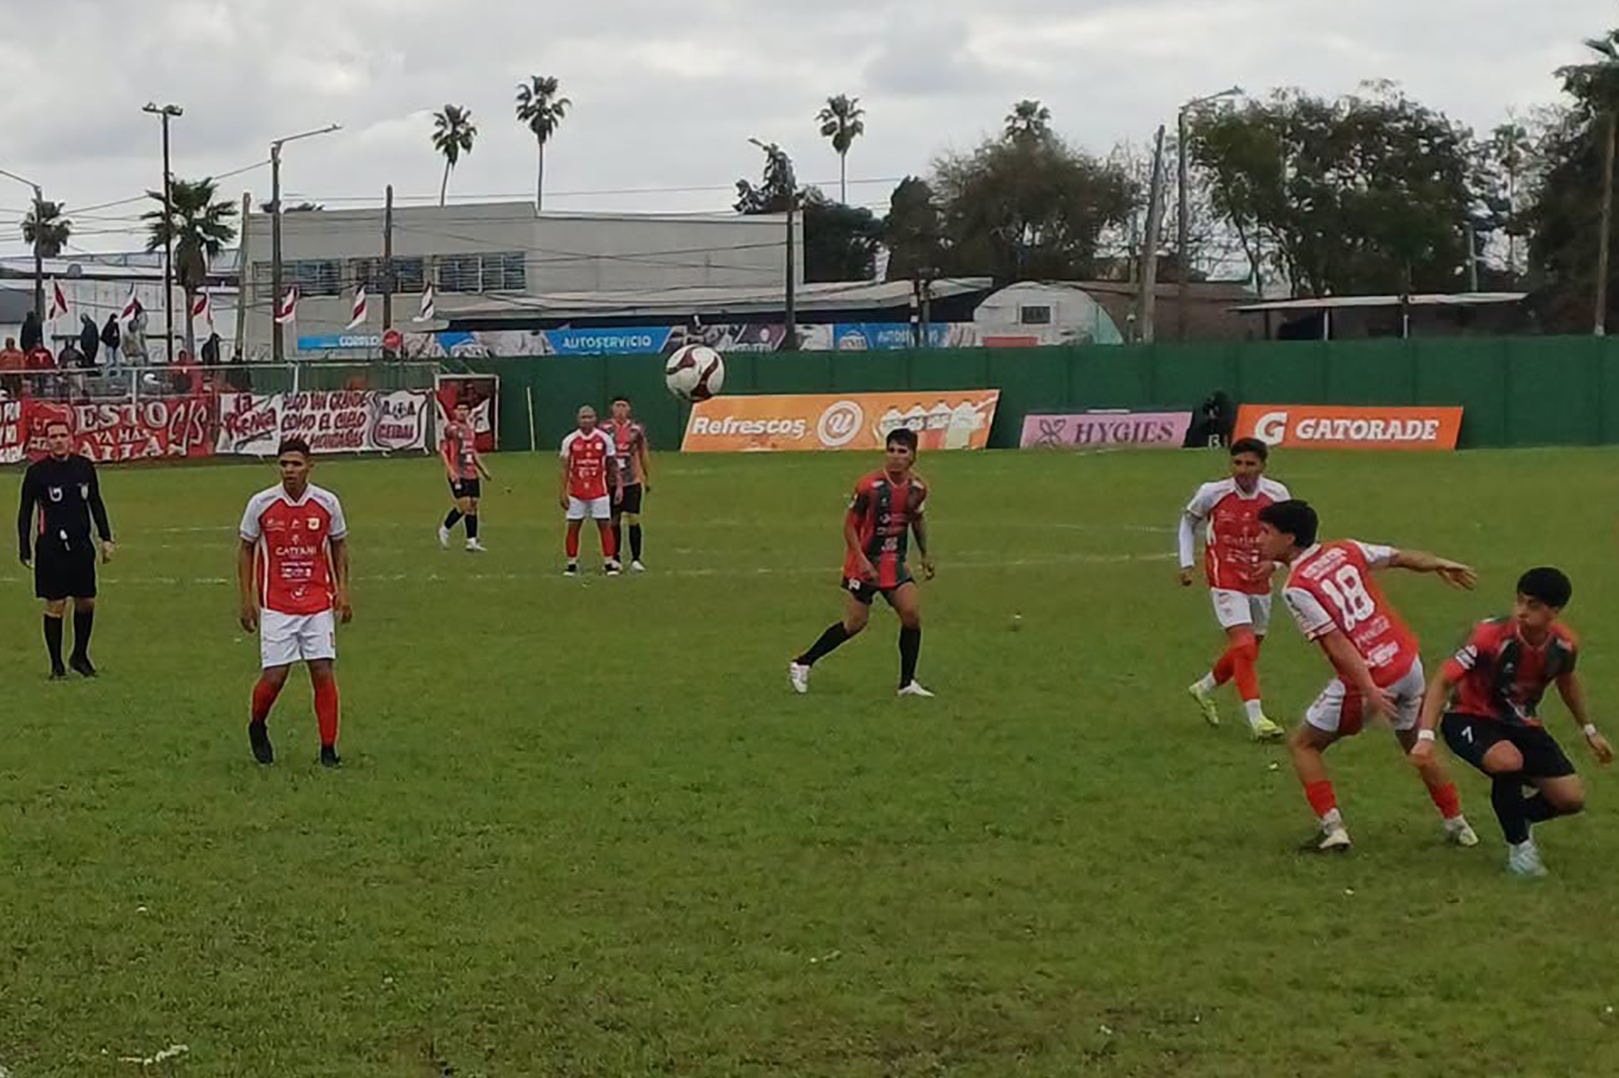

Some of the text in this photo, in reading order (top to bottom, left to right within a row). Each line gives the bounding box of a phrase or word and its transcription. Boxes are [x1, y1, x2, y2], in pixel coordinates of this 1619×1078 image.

[562, 334, 652, 349] AUTOSERVICIO
[78, 401, 168, 432] ESTO
[319, 412, 331, 431] EL
[691, 416, 806, 436] Refrescos
[1073, 420, 1175, 444] HYGIES
[1254, 411, 1288, 447] G
[1296, 418, 1440, 440] GATORADE
[1319, 564, 1376, 632] 18
